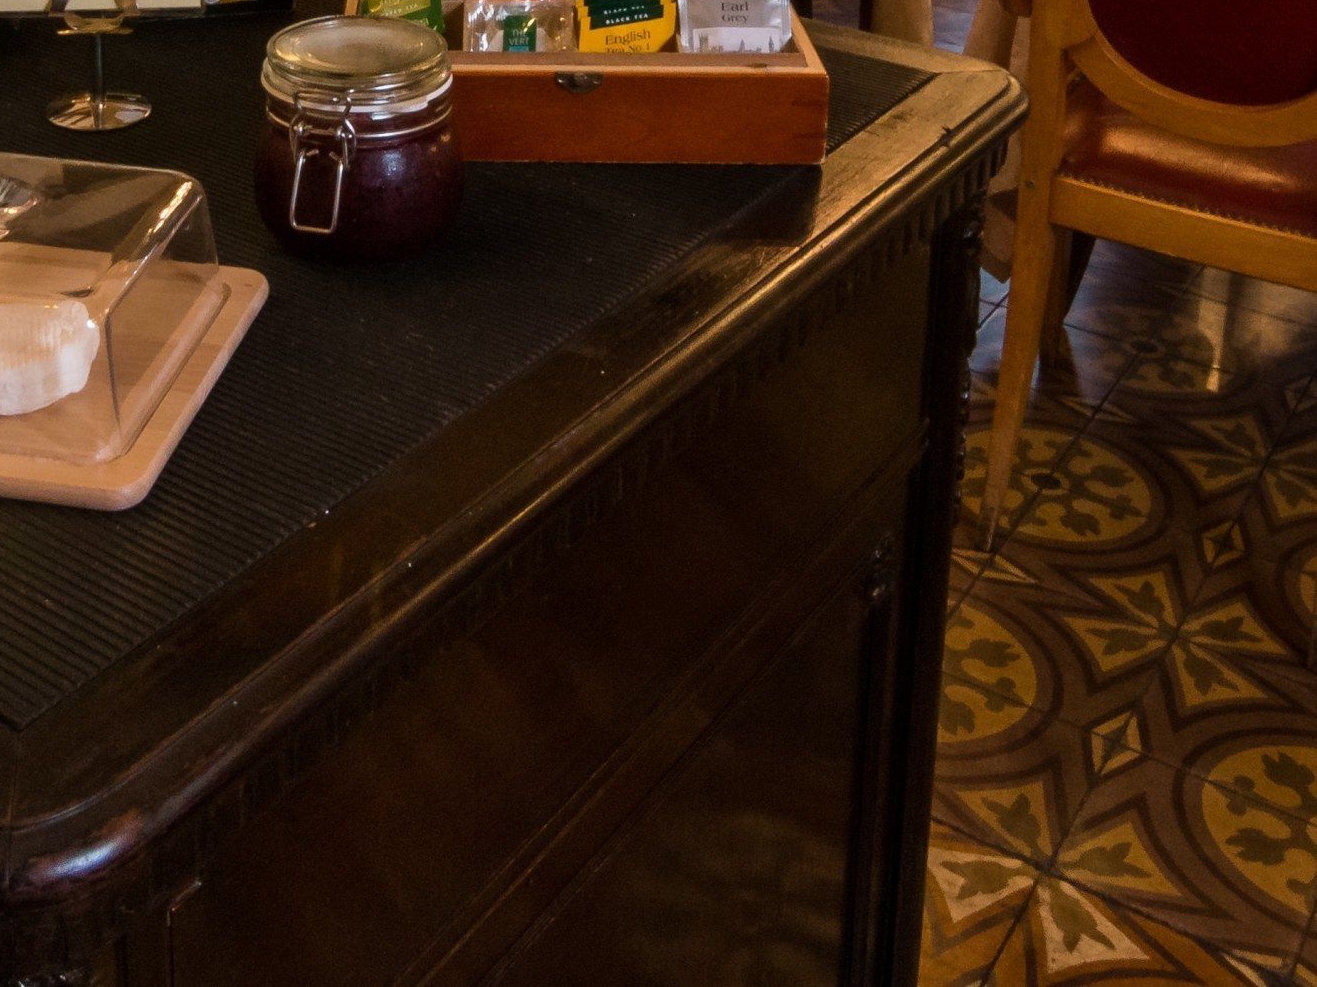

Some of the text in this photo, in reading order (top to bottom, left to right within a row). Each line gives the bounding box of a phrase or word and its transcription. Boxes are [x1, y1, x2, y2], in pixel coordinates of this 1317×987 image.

[721, 2, 750, 12] Earl
[605, 17, 631, 25] BLACK
[721, 15, 751, 24] Grey
[605, 30, 651, 46] English
